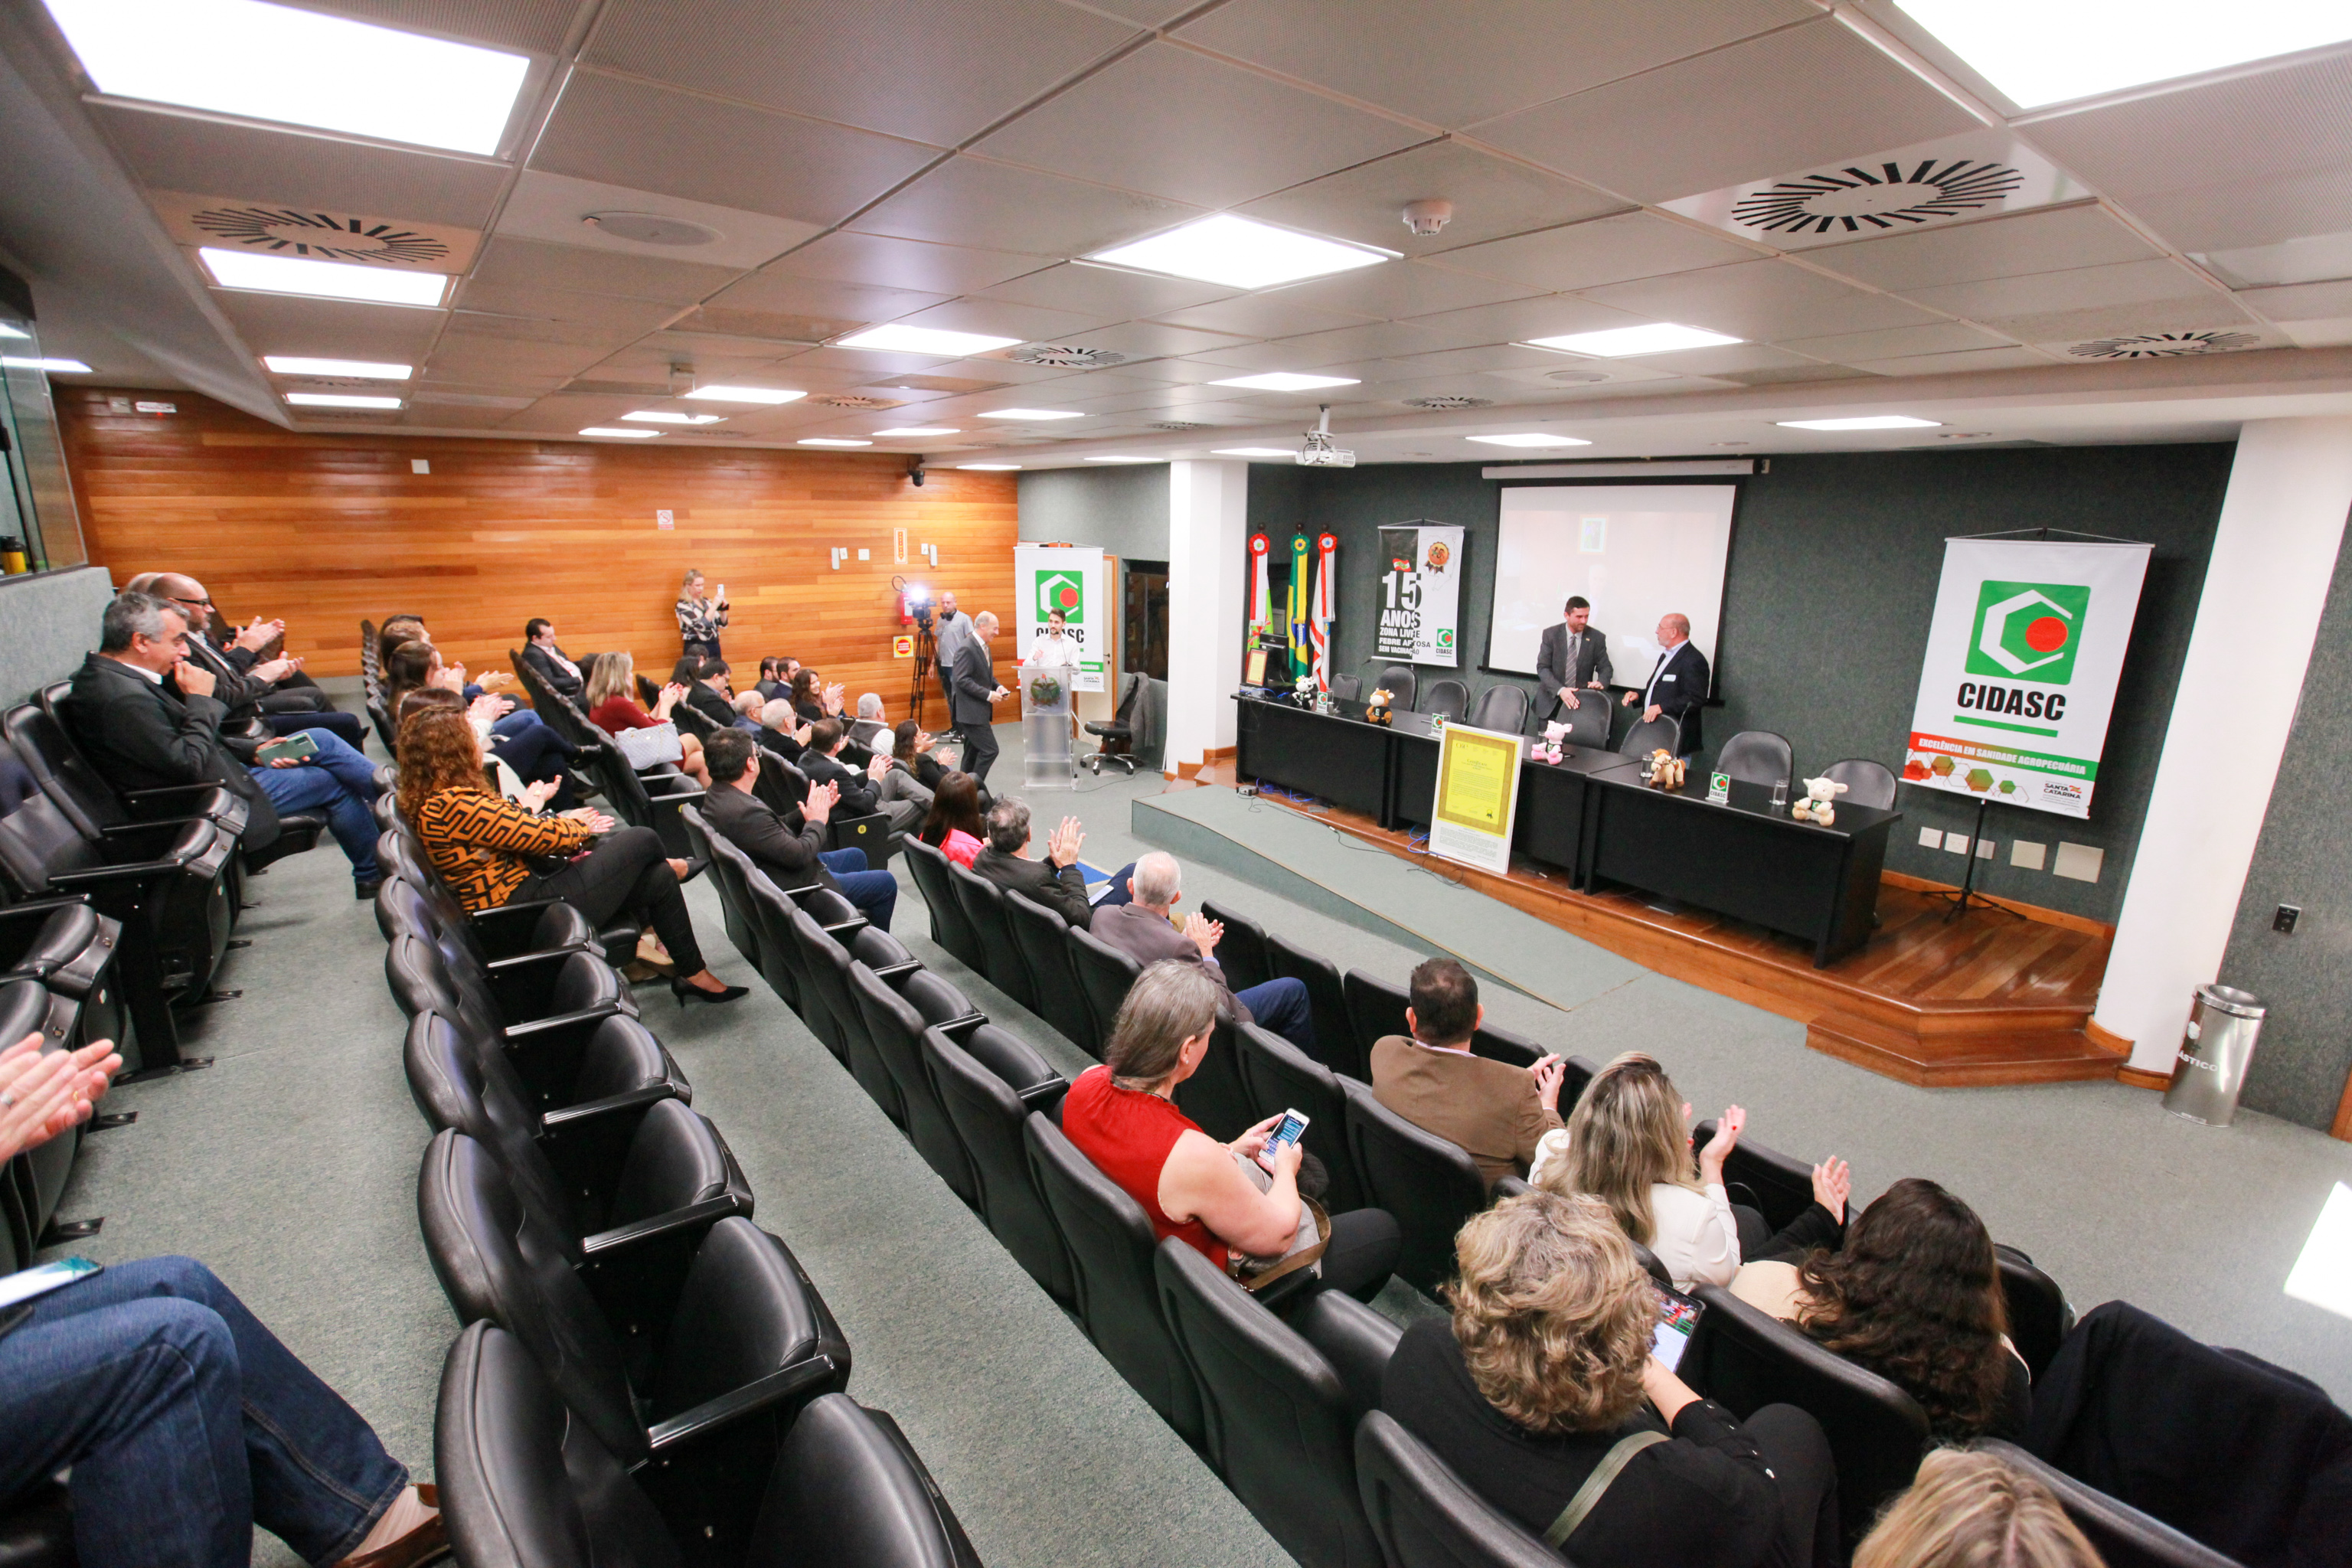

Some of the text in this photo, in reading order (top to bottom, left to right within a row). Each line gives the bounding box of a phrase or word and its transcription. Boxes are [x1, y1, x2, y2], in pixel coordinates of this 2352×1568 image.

[1382, 570, 1422, 610] 15
[1380, 609, 1420, 629] ANOS
[1036, 627, 1084, 643] CSC
[1380, 627, 1420, 638] ZONA LIVRE
[1379, 637, 1431, 648] FEBRE AFTOSA
[1957, 682, 2066, 721] CIDASC
[1919, 738, 2086, 775] EXCELÊNCIA EM SANIDADE AGROPECUÁRIA
[2043, 788, 2081, 799] CATARINA
[2044, 783, 2069, 792] SANTA
[1710, 790, 1726, 799] CIDASC
